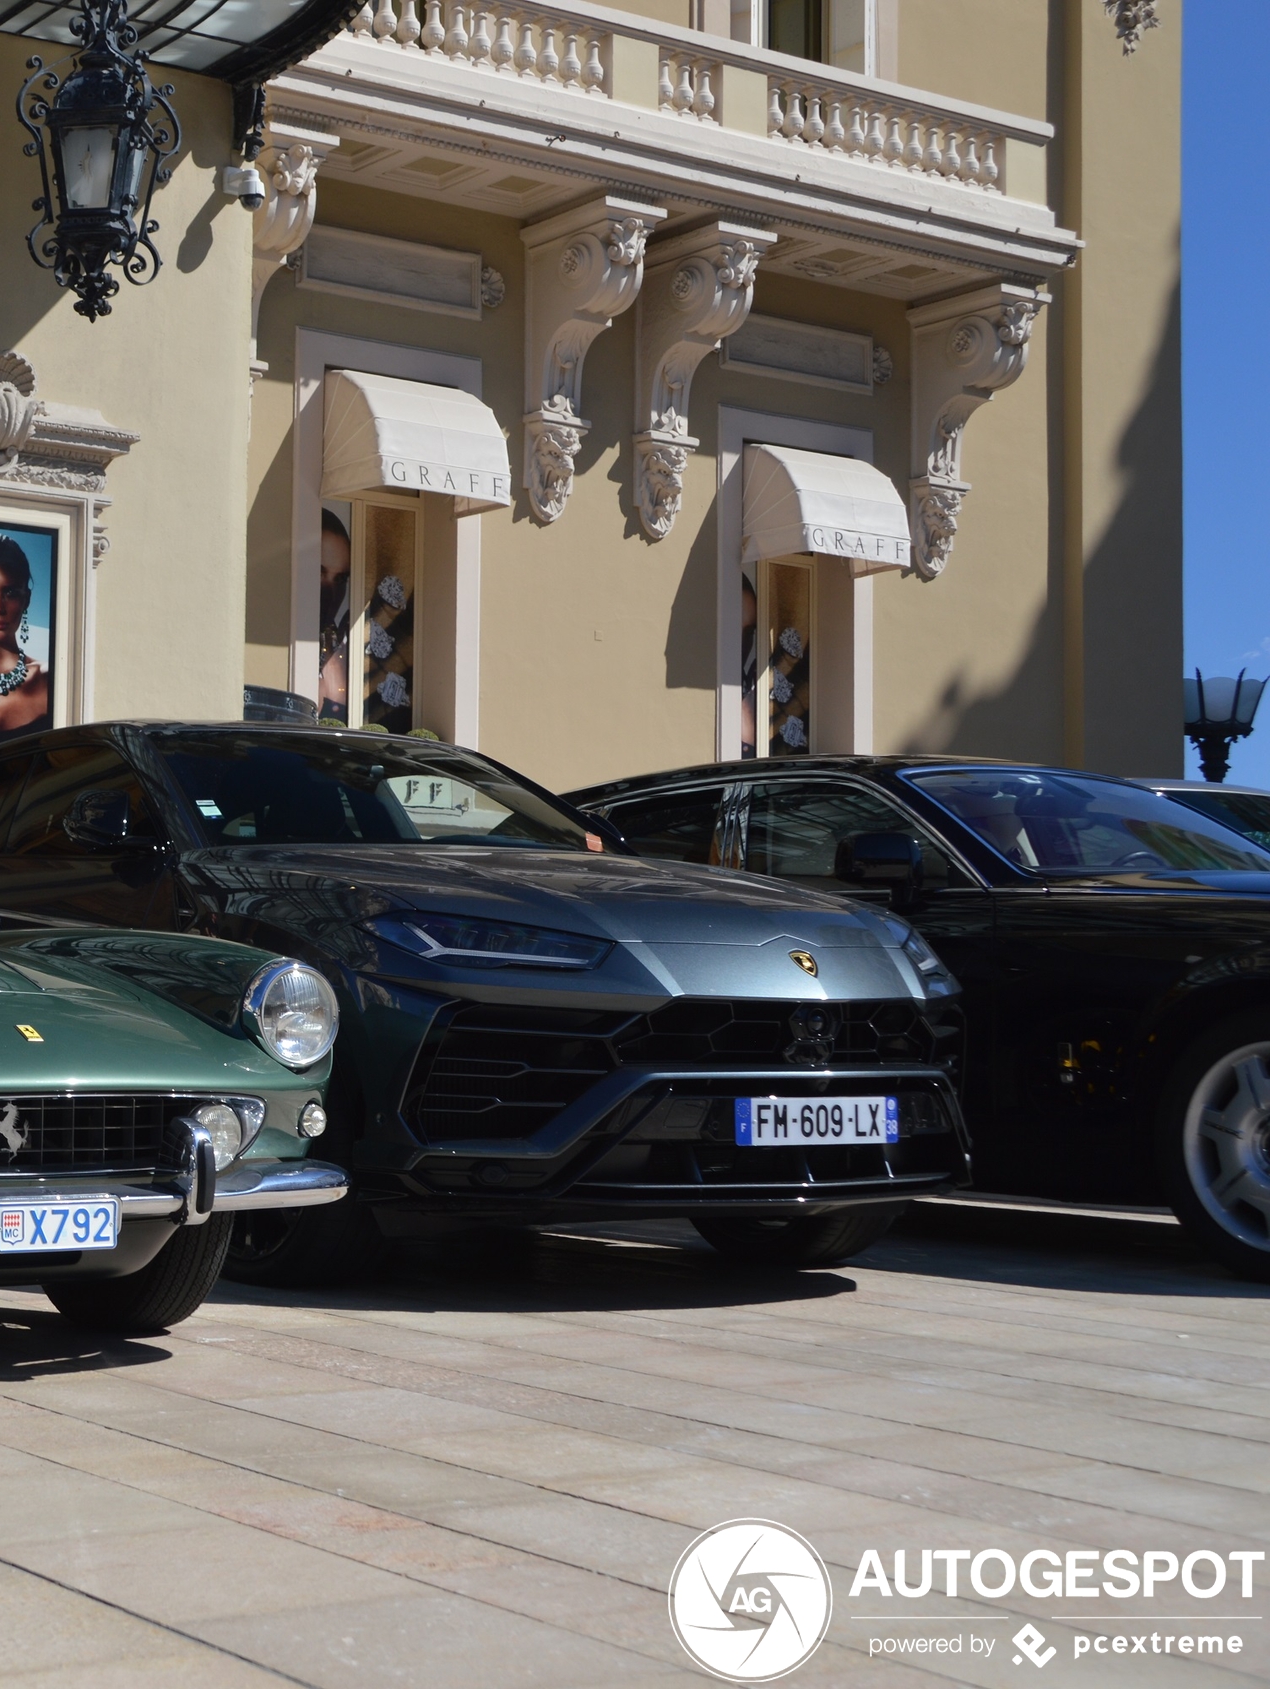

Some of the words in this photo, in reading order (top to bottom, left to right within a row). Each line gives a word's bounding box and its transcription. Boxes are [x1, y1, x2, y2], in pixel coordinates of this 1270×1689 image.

[391, 461, 503, 497] GRAFF
[812, 528, 905, 559] GRAFF
[740, 1122, 747, 1133] F
[756, 1104, 880, 1138] FM-609-LX
[885, 1119, 898, 1135] 38
[4, 1228, 19, 1238] MC
[30, 1207, 111, 1245] X792
